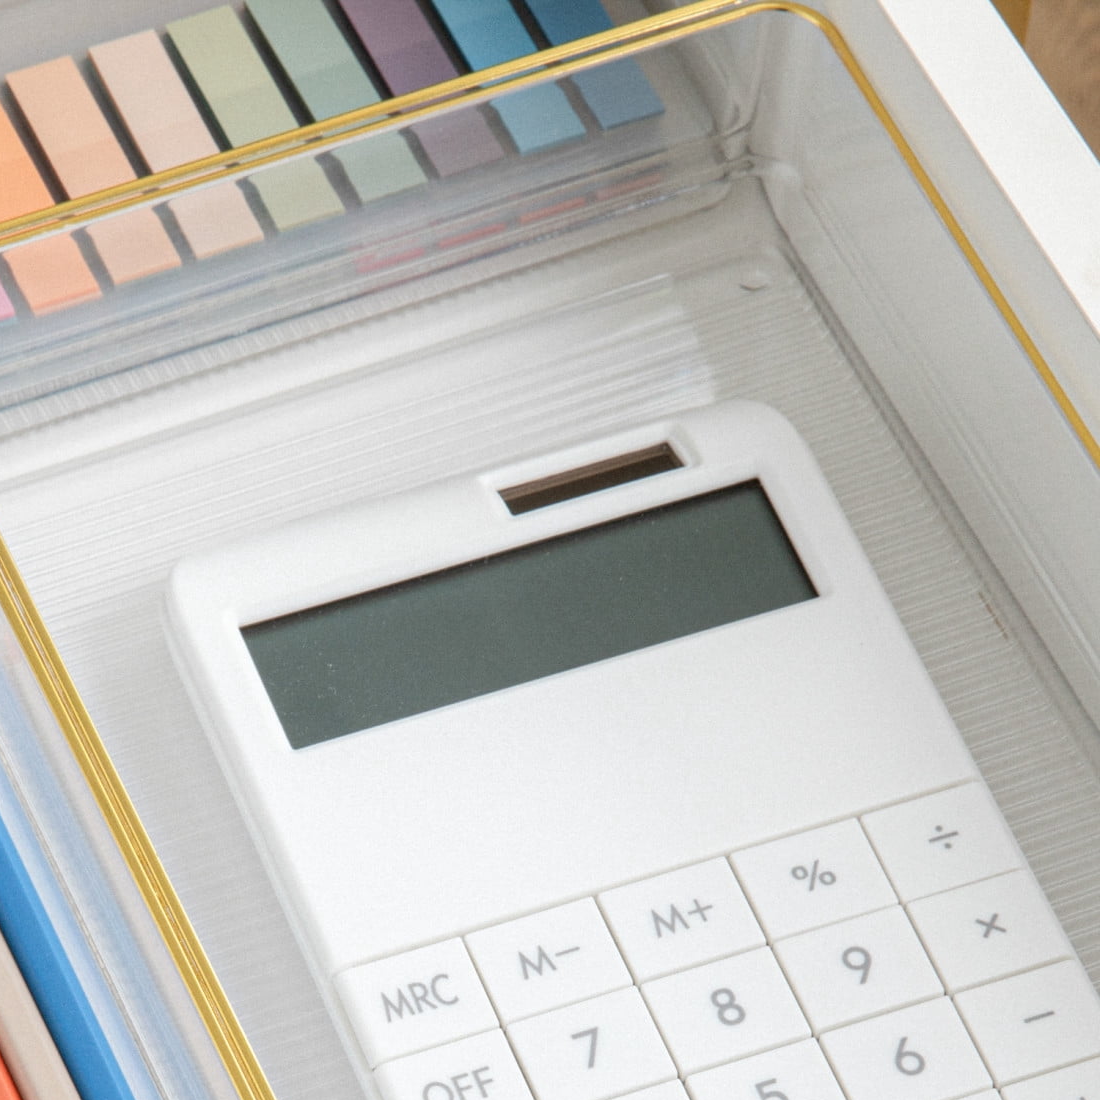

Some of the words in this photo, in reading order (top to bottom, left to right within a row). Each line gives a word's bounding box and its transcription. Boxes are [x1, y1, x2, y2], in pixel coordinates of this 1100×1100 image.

[651, 899, 713, 938] M+
[842, 946, 872, 984] 9
[381, 974, 459, 1022] MRC
[710, 988, 746, 1026] 8
[571, 1027, 598, 1069] 7
[895, 1037, 925, 1076] 6
